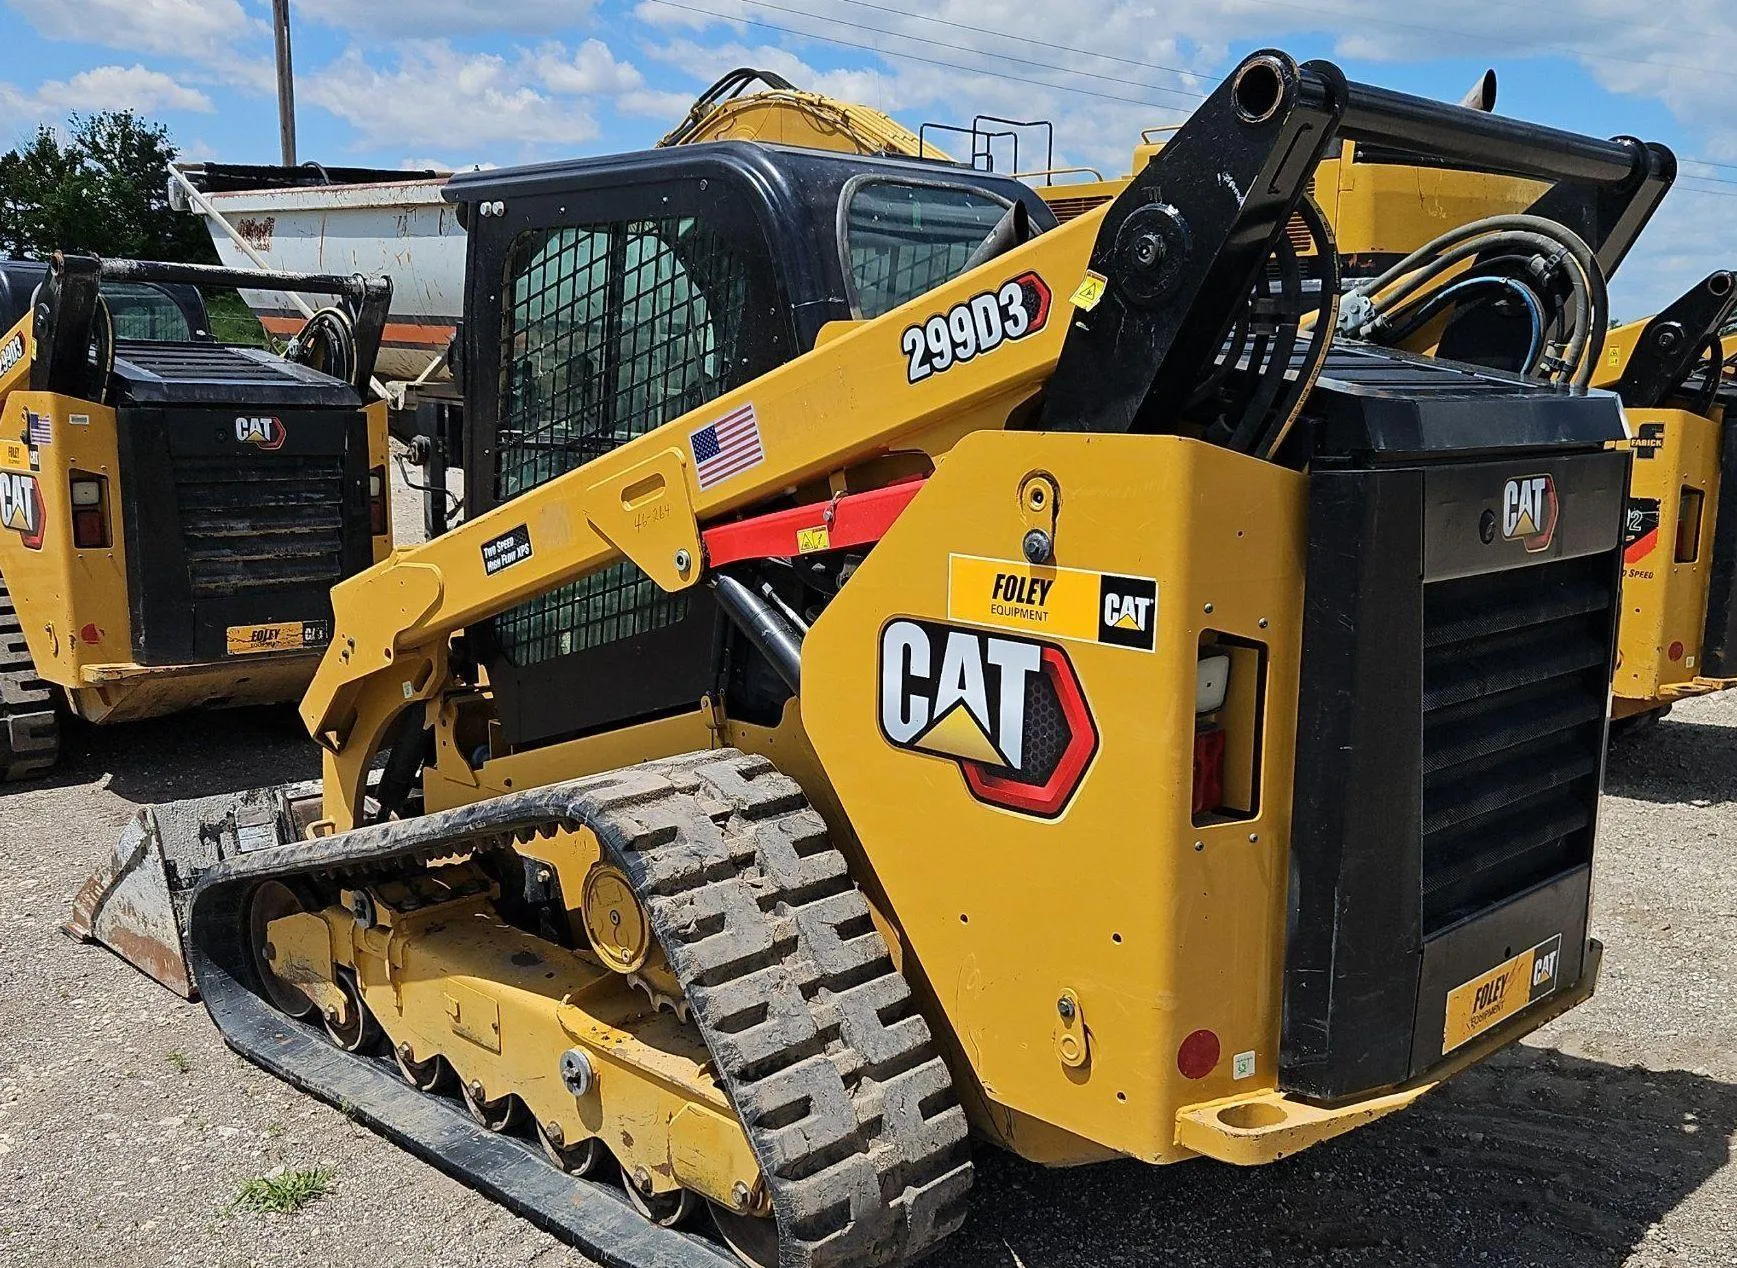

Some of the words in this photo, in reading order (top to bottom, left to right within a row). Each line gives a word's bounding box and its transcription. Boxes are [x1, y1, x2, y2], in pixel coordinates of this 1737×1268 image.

[903, 282, 1028, 381] 299D3
[236, 417, 272, 441] CAT
[1631, 439, 1662, 447] FABICK
[0, 472, 33, 531] CAT
[1503, 478, 1545, 536] CAT
[497, 536, 514, 553] SPEED
[516, 543, 530, 558] XPS
[992, 573, 1053, 606] FOLEY
[1628, 568, 1654, 579] SPEED
[991, 604, 1049, 622] EQUIPMENT
[1104, 592, 1154, 632] CAT
[252, 629, 280, 642] FOLEY
[883, 621, 1041, 770] CAT
[1533, 951, 1557, 986] CAT
[1472, 973, 1509, 1013] FOLEY
